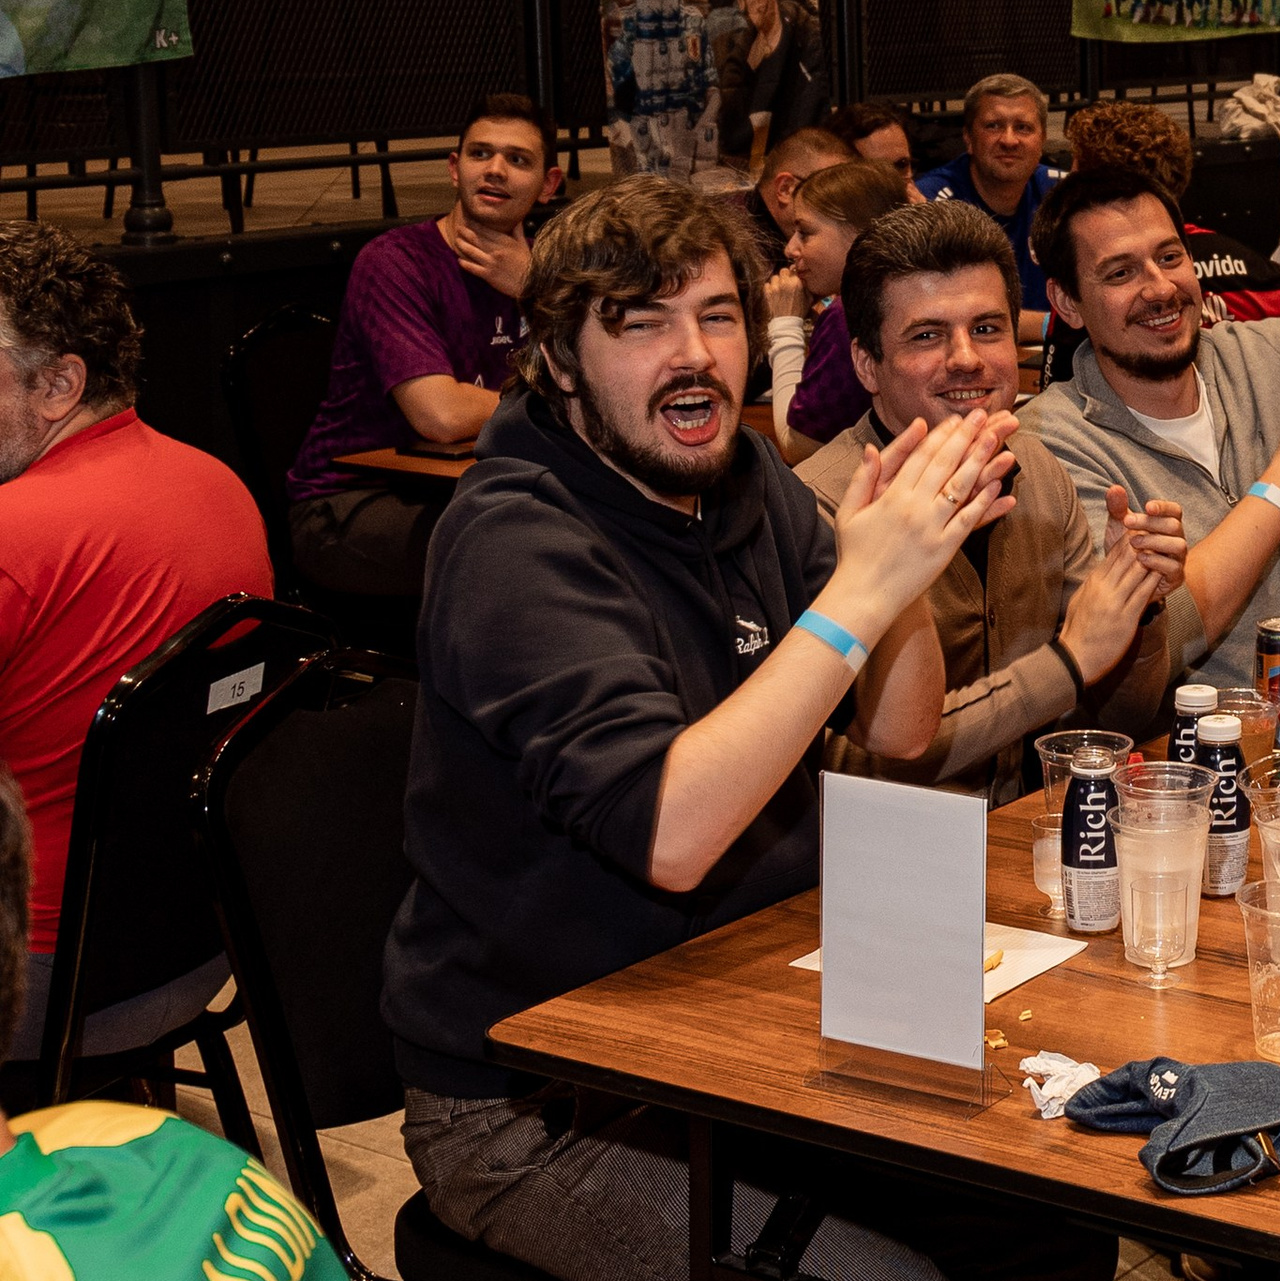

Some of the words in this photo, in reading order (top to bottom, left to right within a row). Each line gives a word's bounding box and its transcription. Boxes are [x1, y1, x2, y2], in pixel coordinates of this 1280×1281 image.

[231, 681, 245, 699] 15
[1079, 790, 1107, 862] Rich
[1212, 757, 1238, 827] Rich
